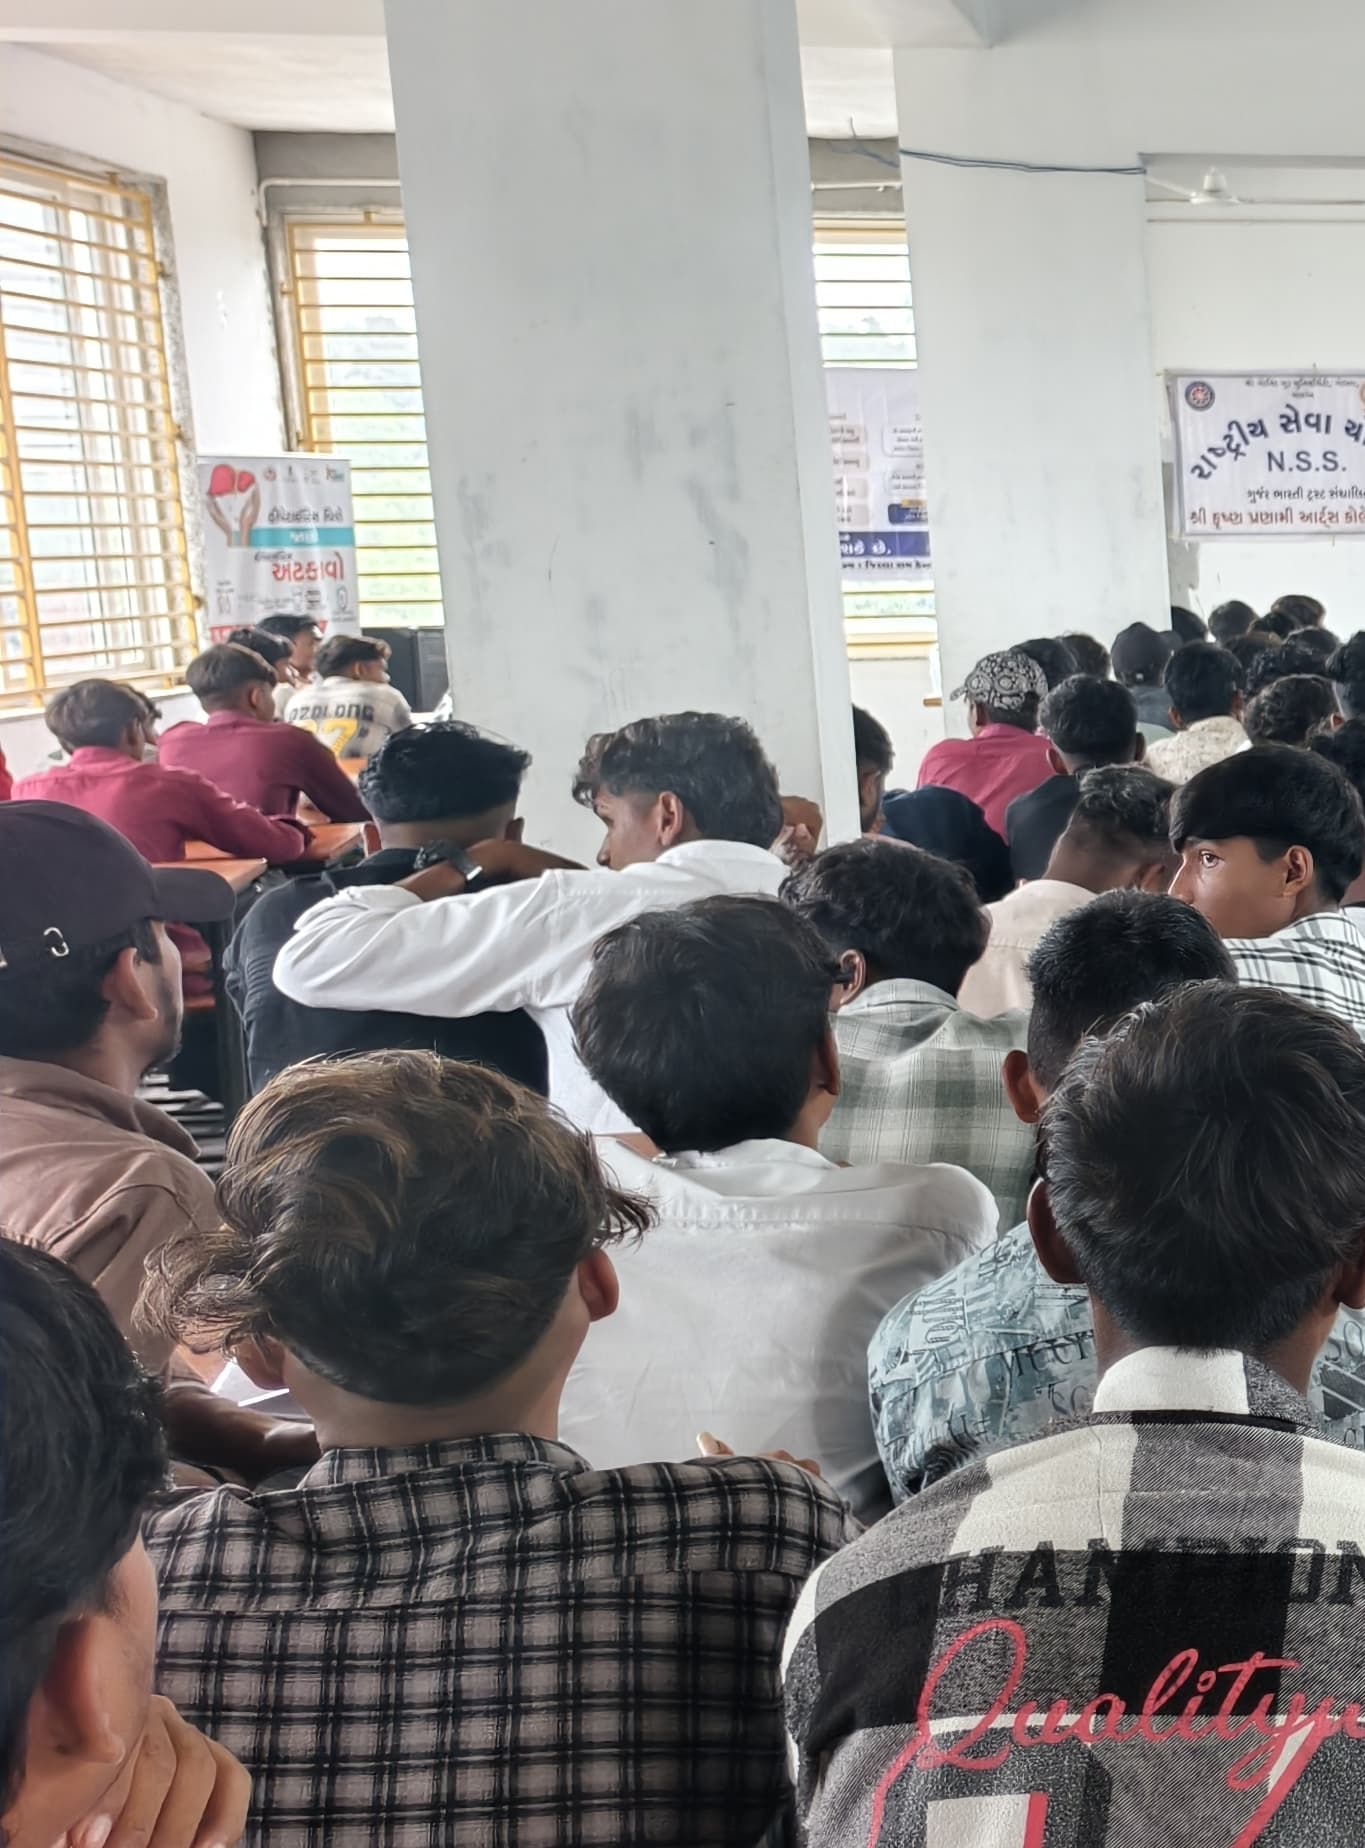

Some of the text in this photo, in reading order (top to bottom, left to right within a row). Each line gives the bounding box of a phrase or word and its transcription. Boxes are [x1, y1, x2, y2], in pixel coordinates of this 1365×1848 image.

[1190, 419, 1269, 481] રાષ્ટ્રીય
[1279, 403, 1332, 435] સેવા
[1267, 450, 1348, 473] N.S.S.
[1190, 507, 1207, 526] શ્રી
[272, 551, 344, 582] અટકાવો
